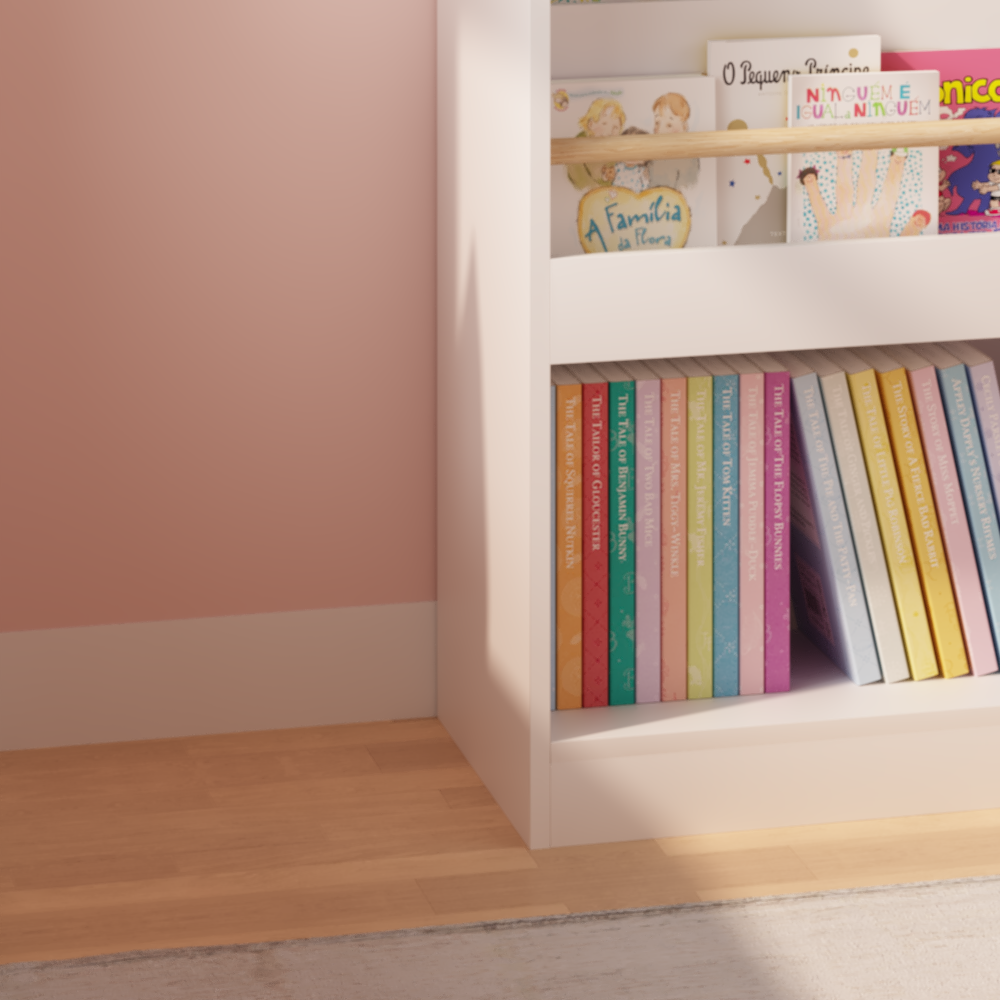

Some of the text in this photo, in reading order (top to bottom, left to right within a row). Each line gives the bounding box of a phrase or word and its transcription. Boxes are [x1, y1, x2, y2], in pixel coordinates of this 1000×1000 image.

[722, 61, 736, 86] O
[584, 195, 682, 253] A Família
[634, 226, 672, 248] Flora
[774, 383, 785, 408] THE
[774, 408, 785, 438] TALE
[591, 394, 602, 551] THE TAILOR OF GLOUCESTER
[722, 386, 733, 527] THE TALE OF TOM KITTEN
[774, 454, 785, 479] THE
[616, 393, 628, 562] THE TALE OF BENJAMIN BUNNY
[774, 480, 785, 519] FLOPSY
[774, 522, 785, 571] BUNNIES
